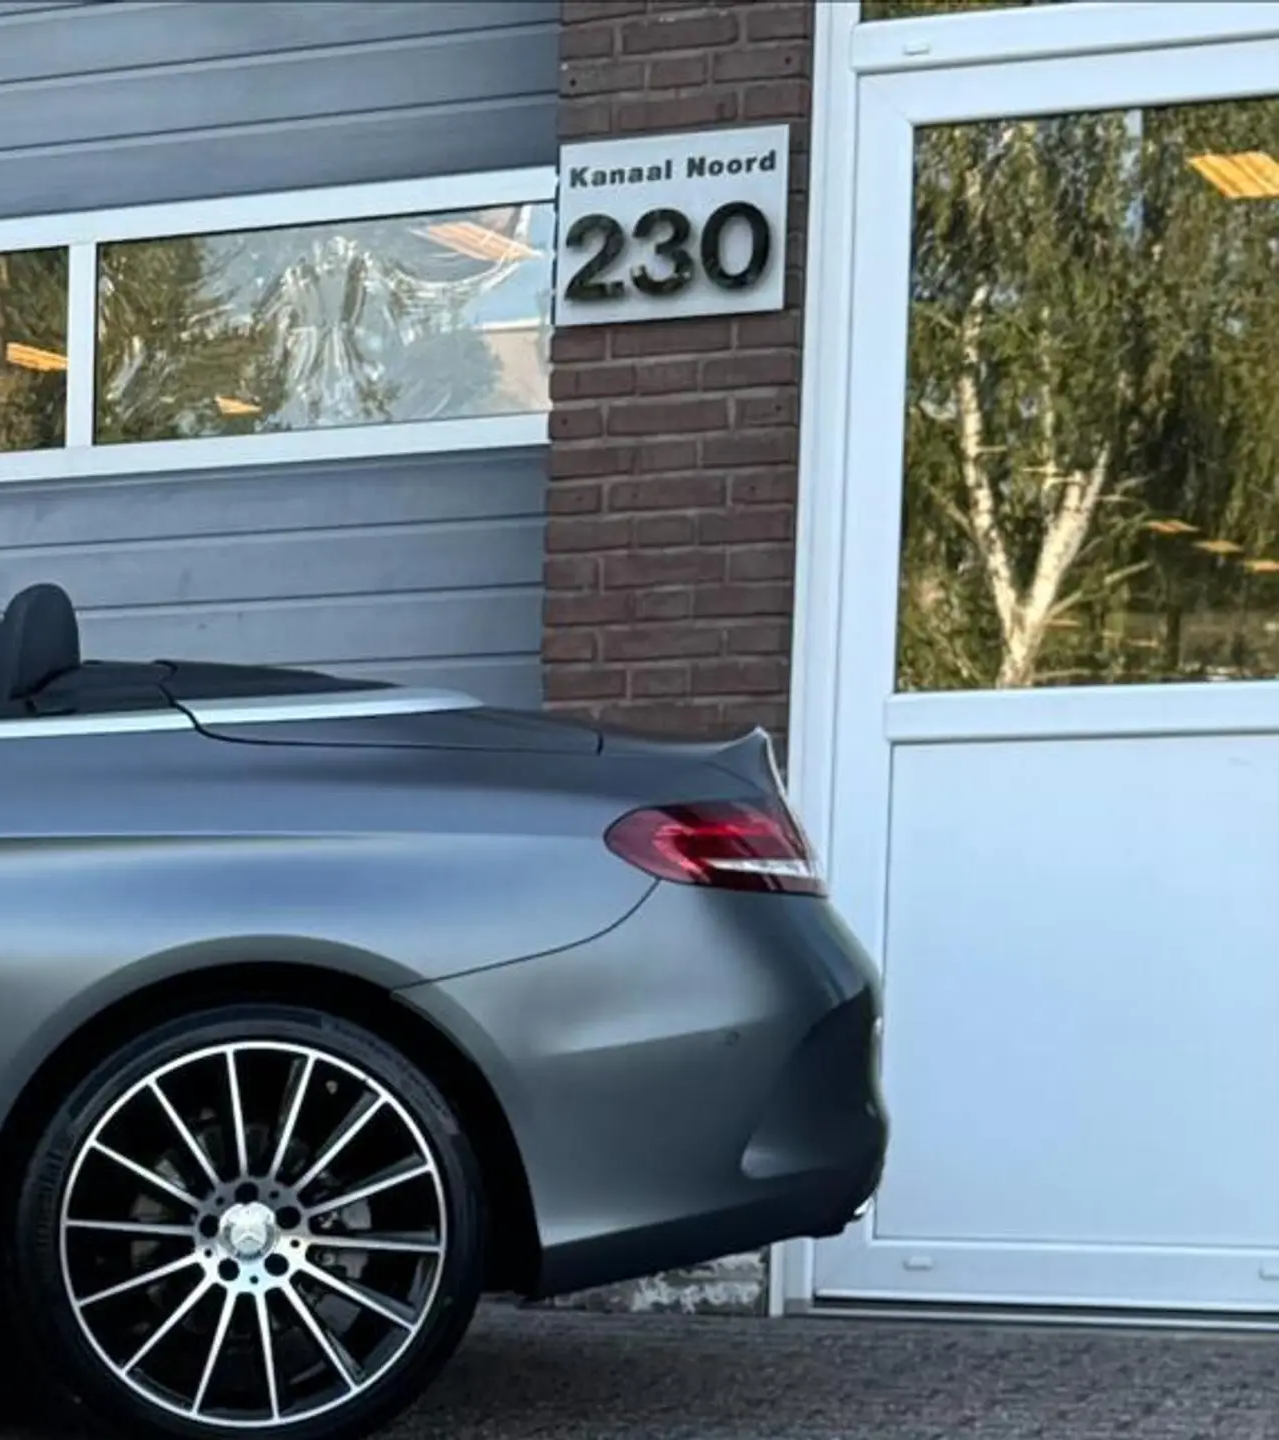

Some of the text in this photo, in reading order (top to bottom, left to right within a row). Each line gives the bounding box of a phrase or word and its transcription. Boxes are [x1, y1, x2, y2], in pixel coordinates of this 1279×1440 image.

[569, 150, 777, 188] Kanaal Noord
[564, 200, 771, 301] 230
